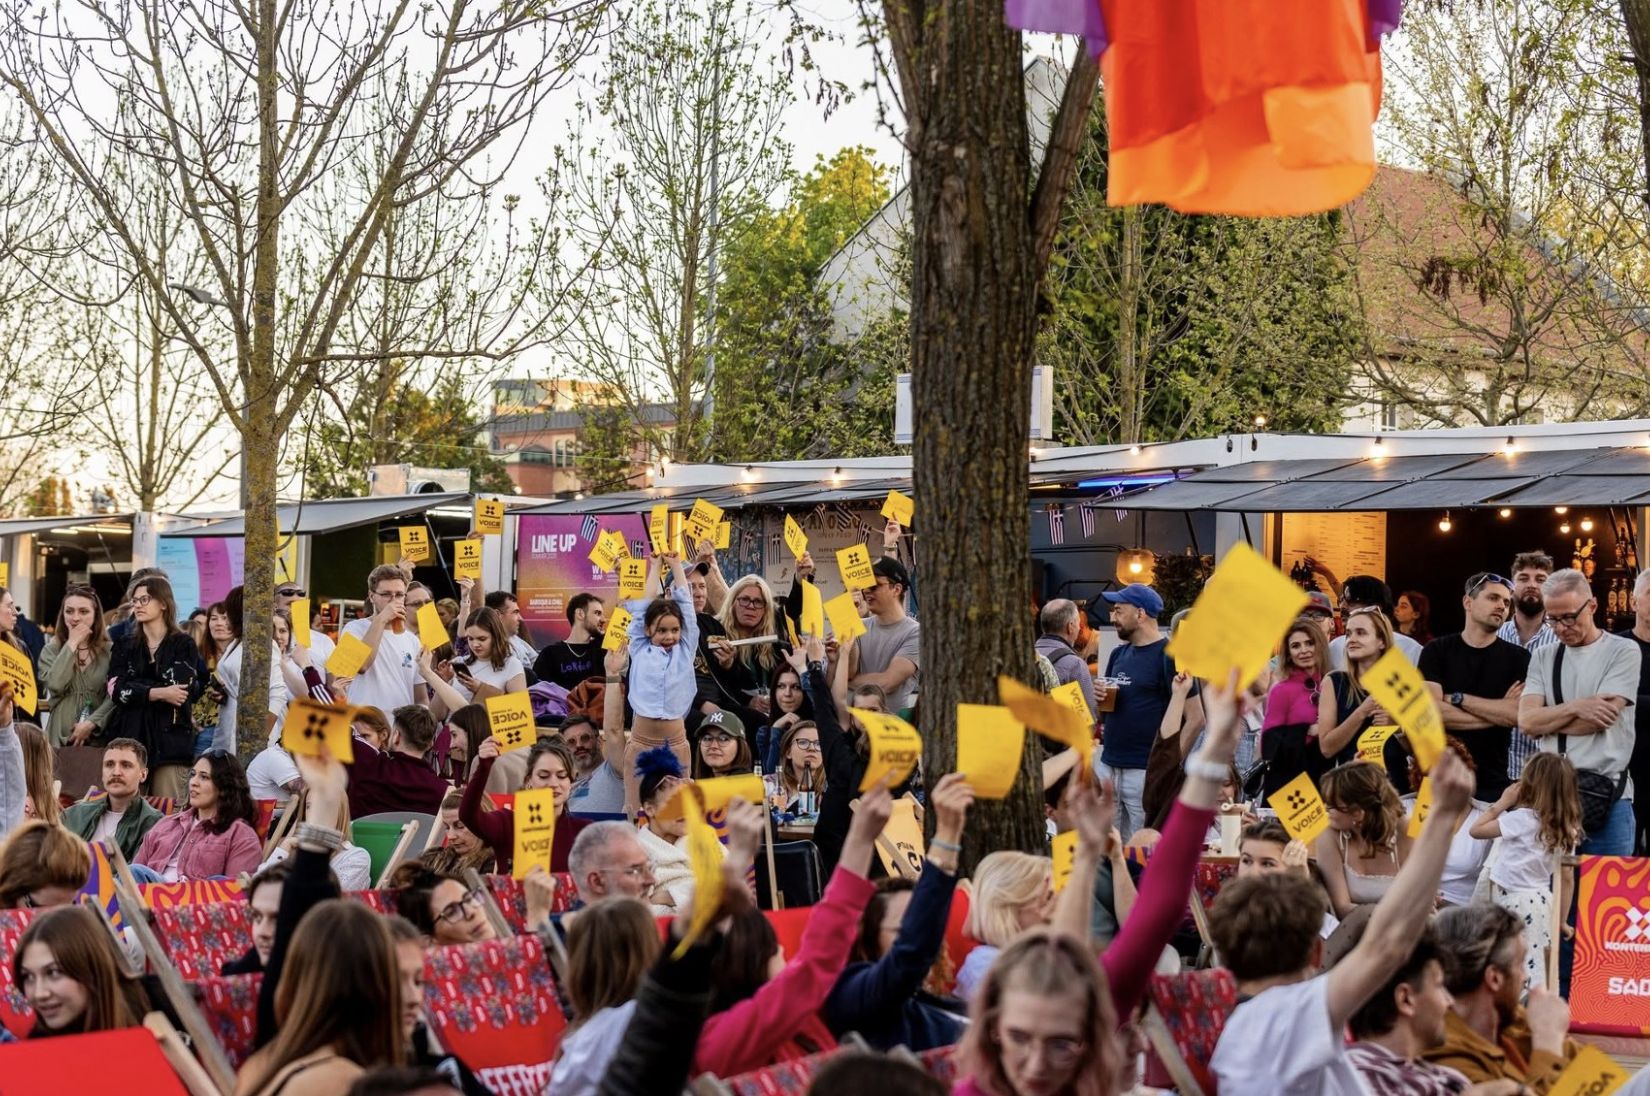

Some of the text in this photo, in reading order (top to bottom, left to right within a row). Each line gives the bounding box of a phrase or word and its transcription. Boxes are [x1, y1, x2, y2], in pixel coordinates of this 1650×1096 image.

[479, 519, 501, 527] VOICE
[693, 510, 714, 525] VOICE
[405, 546, 426, 554] VOICE
[531, 533, 577, 553] LINE UP
[597, 547, 614, 565] VOICE
[458, 561, 479, 569] VOICE
[845, 566, 870, 580] VOICE
[492, 710, 528, 725] VOICE
[1363, 745, 1381, 755] OICE
[1293, 805, 1323, 833] VOICE
